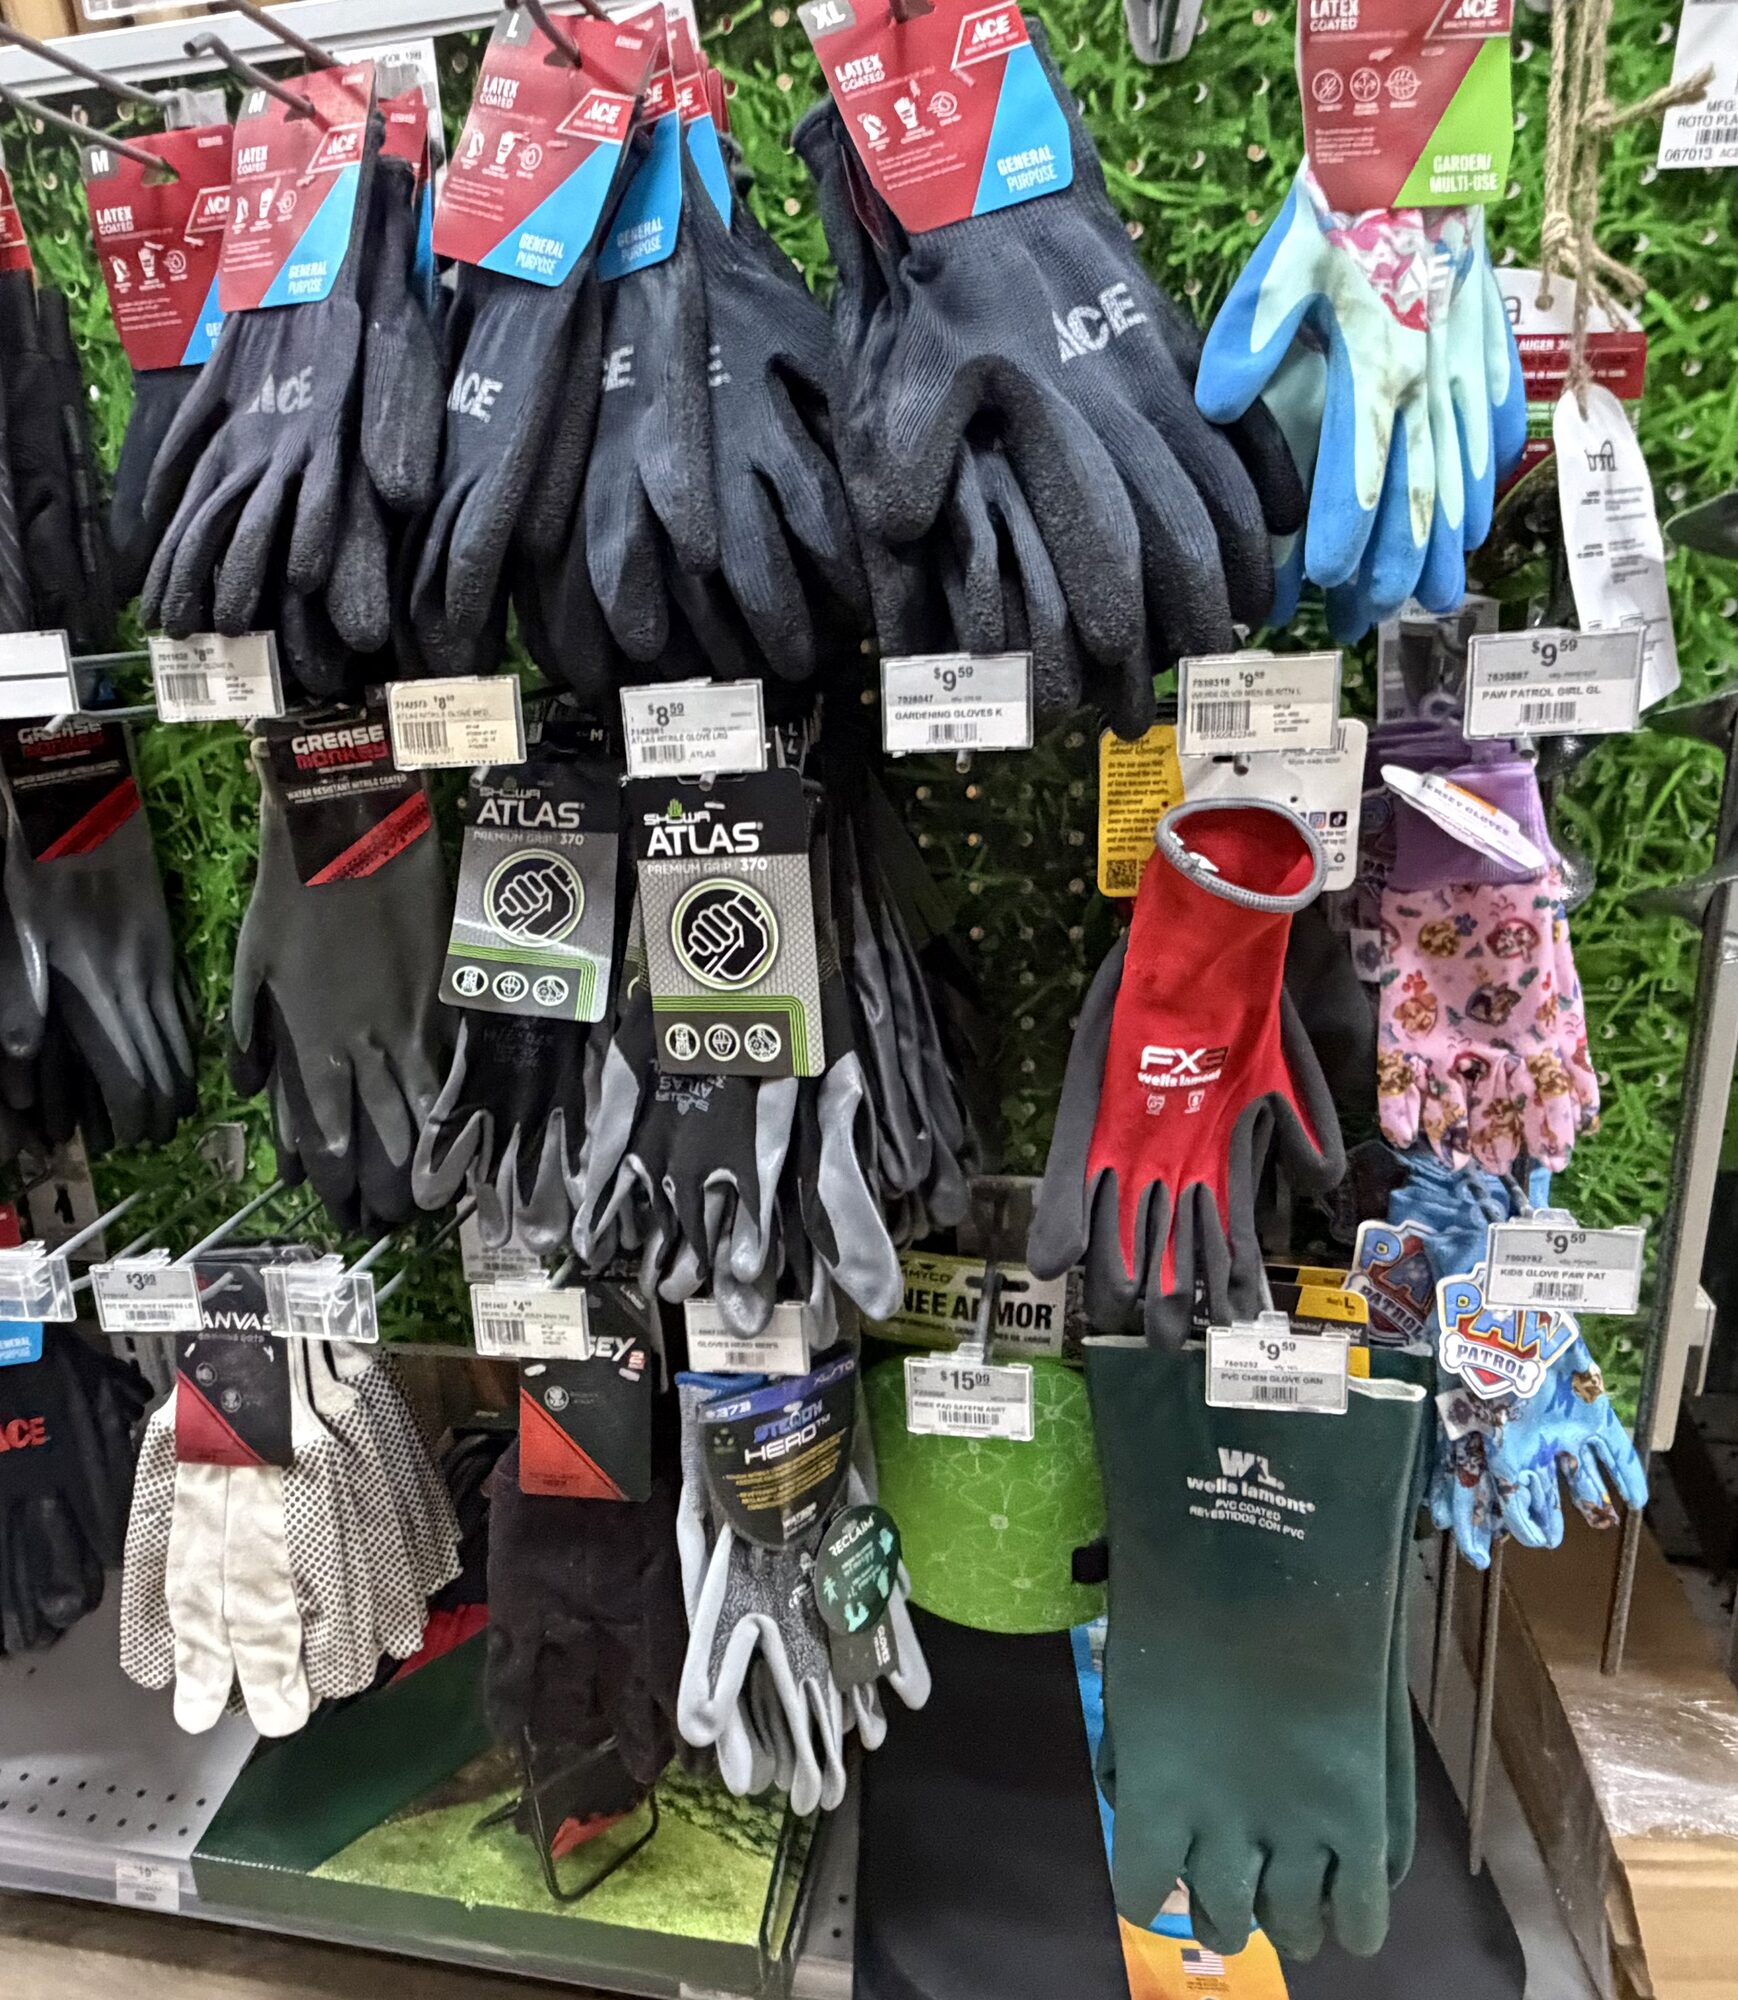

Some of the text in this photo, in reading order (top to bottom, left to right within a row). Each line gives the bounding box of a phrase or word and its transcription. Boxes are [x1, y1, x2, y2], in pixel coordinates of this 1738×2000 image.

[507, 13, 520, 38] L
[810, 1, 846, 30] XL
[1310, 18, 1358, 31] COATED
[971, 14, 1011, 44] ACE
[834, 53, 882, 82] LATEX
[482, 74, 520, 98] LATEX
[840, 70, 885, 93] COATED
[248, 90, 266, 113] M
[480, 94, 514, 110] COATED
[584, 100, 622, 125] ACE
[238, 146, 268, 165] LATEX
[327, 134, 358, 155] ACE
[91, 150, 109, 174] M
[237, 160, 267, 175] COATED
[996, 144, 1055, 176] GENERAL
[1006, 164, 1058, 193] PURPOSE
[1429, 174, 1498, 194] MULTI-USE
[96, 206, 133, 224] LATEX
[100, 222, 134, 235] COATED
[518, 233, 565, 260] GENERAL
[288, 261, 327, 277] GENERAL
[515, 249, 557, 275] PURPOSE
[288, 279, 323, 295] PURPOSE
[1052, 282, 1148, 363] ACE
[247, 366, 313, 416] ACE
[1482, 691, 1507, 700] PAW
[1510, 688, 1553, 698] PATROL
[895, 711, 950, 720] GARDENING
[954, 709, 992, 718] GLOVES
[292, 724, 385, 755] GREASE
[286, 788, 311, 801] WATER
[313, 782, 350, 797] RESISTANT
[477, 800, 580, 829] ATLAS
[560, 834, 584, 846] 370
[647, 822, 760, 857] ATLAS
[648, 859, 768, 875] PREMIUM GRIP 370
[1526, 1269, 1559, 1278] GLOVE
[1587, 1272, 1606, 1280] PAT
[1444, 1281, 1573, 1361] PAW
[1457, 1343, 1527, 1383] PATROL
[1216, 1499, 1281, 1522] PVC COATED
[1189, 1505, 1305, 1541] REVESTIDOS CON PVC
[828, 1516, 875, 1557] RECLAIM
